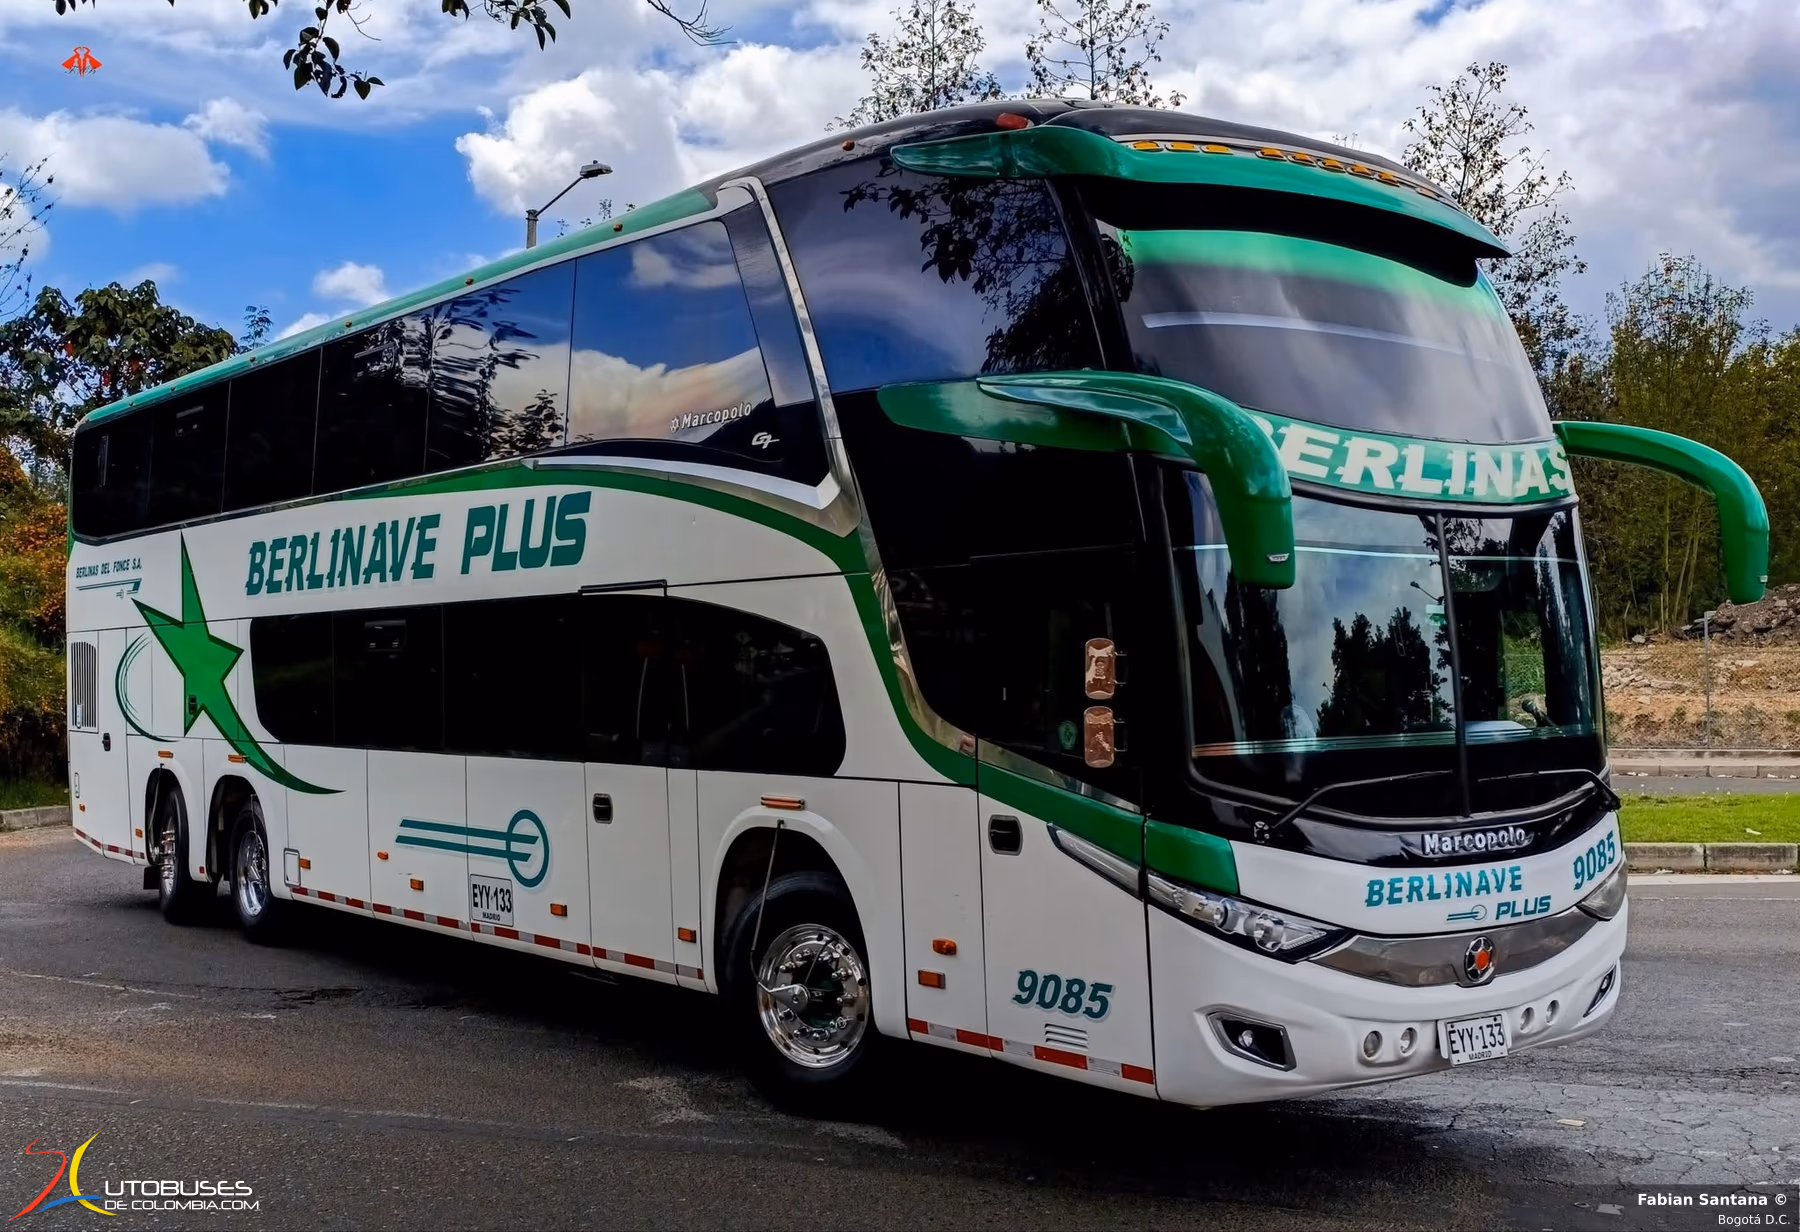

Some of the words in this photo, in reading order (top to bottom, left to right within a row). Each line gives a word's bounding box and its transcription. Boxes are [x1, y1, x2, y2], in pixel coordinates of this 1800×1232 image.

[681, 403, 752, 430] Marcopolo
[245, 513, 441, 596] BERLINAVE
[461, 491, 592, 575] PLUS
[76, 564, 99, 578] BERLINAS
[101, 562, 110, 575] DEL
[113, 559, 130, 573] FONCE
[1422, 826, 1526, 855] Marcopolo
[1573, 830, 1616, 891] 9085
[1365, 866, 1523, 907] BERLINAVE
[482, 911, 501, 921] MADRID
[1496, 895, 1552, 920] PLUS
[1012, 969, 1113, 1019] 9085
[1468, 1050, 1492, 1060] MADRID
